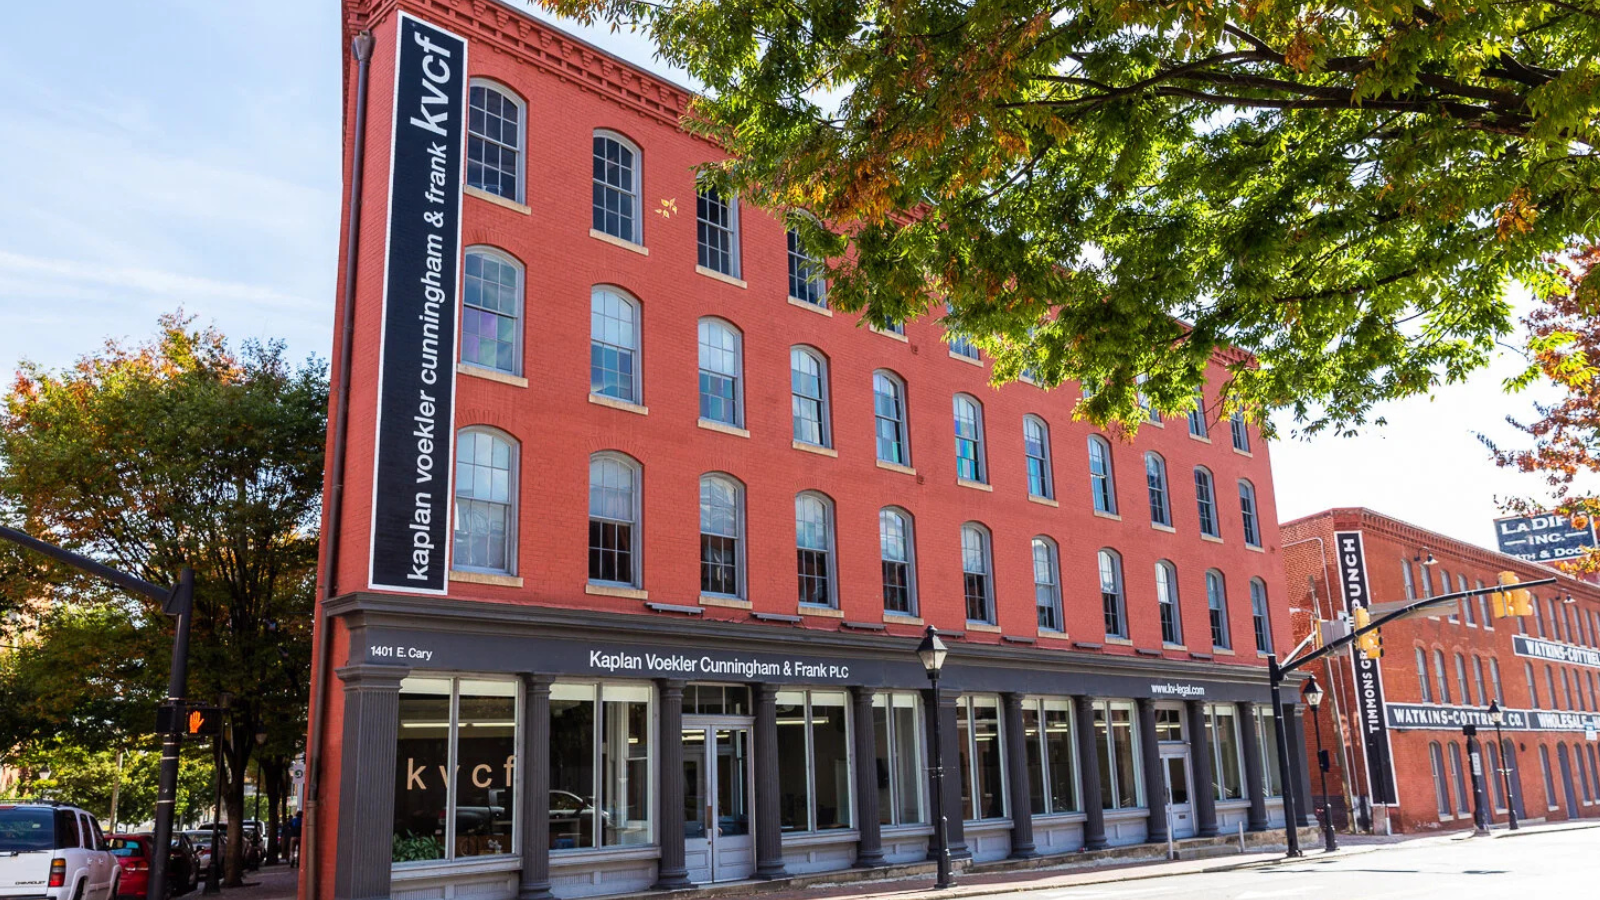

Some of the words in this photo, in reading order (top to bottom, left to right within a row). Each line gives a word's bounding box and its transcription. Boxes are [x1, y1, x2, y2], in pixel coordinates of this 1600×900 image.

[410, 32, 451, 138] kvcf
[424, 141, 447, 204] frank
[423, 209, 444, 228] &
[418, 236, 446, 386] cunningham
[413, 390, 436, 484] voekler
[407, 493, 434, 581] kaplan
[1500, 515, 1570, 535] LADIF
[1527, 533, 1565, 545] INC.
[1539, 549, 1551, 559] &
[1554, 546, 1586, 556] DOC
[1343, 538, 1362, 610] PUNCH
[370, 646, 393, 657] 1401
[396, 646, 406, 657] E.
[408, 647, 433, 661] Cary
[590, 650, 642, 672] Kaplan
[645, 653, 697, 673] Voekler
[700, 656, 780, 678] Cunningham
[783, 660, 792, 676] &
[795, 662, 827, 678] Frank
[829, 667, 849, 679] PLC
[1151, 683, 1205, 697] www.kv-legal.com
[1362, 672, 1380, 734] TIMMONS
[1393, 708, 1508, 726] WATKINS-COTTREL
[1508, 713, 1523, 727] CO.
